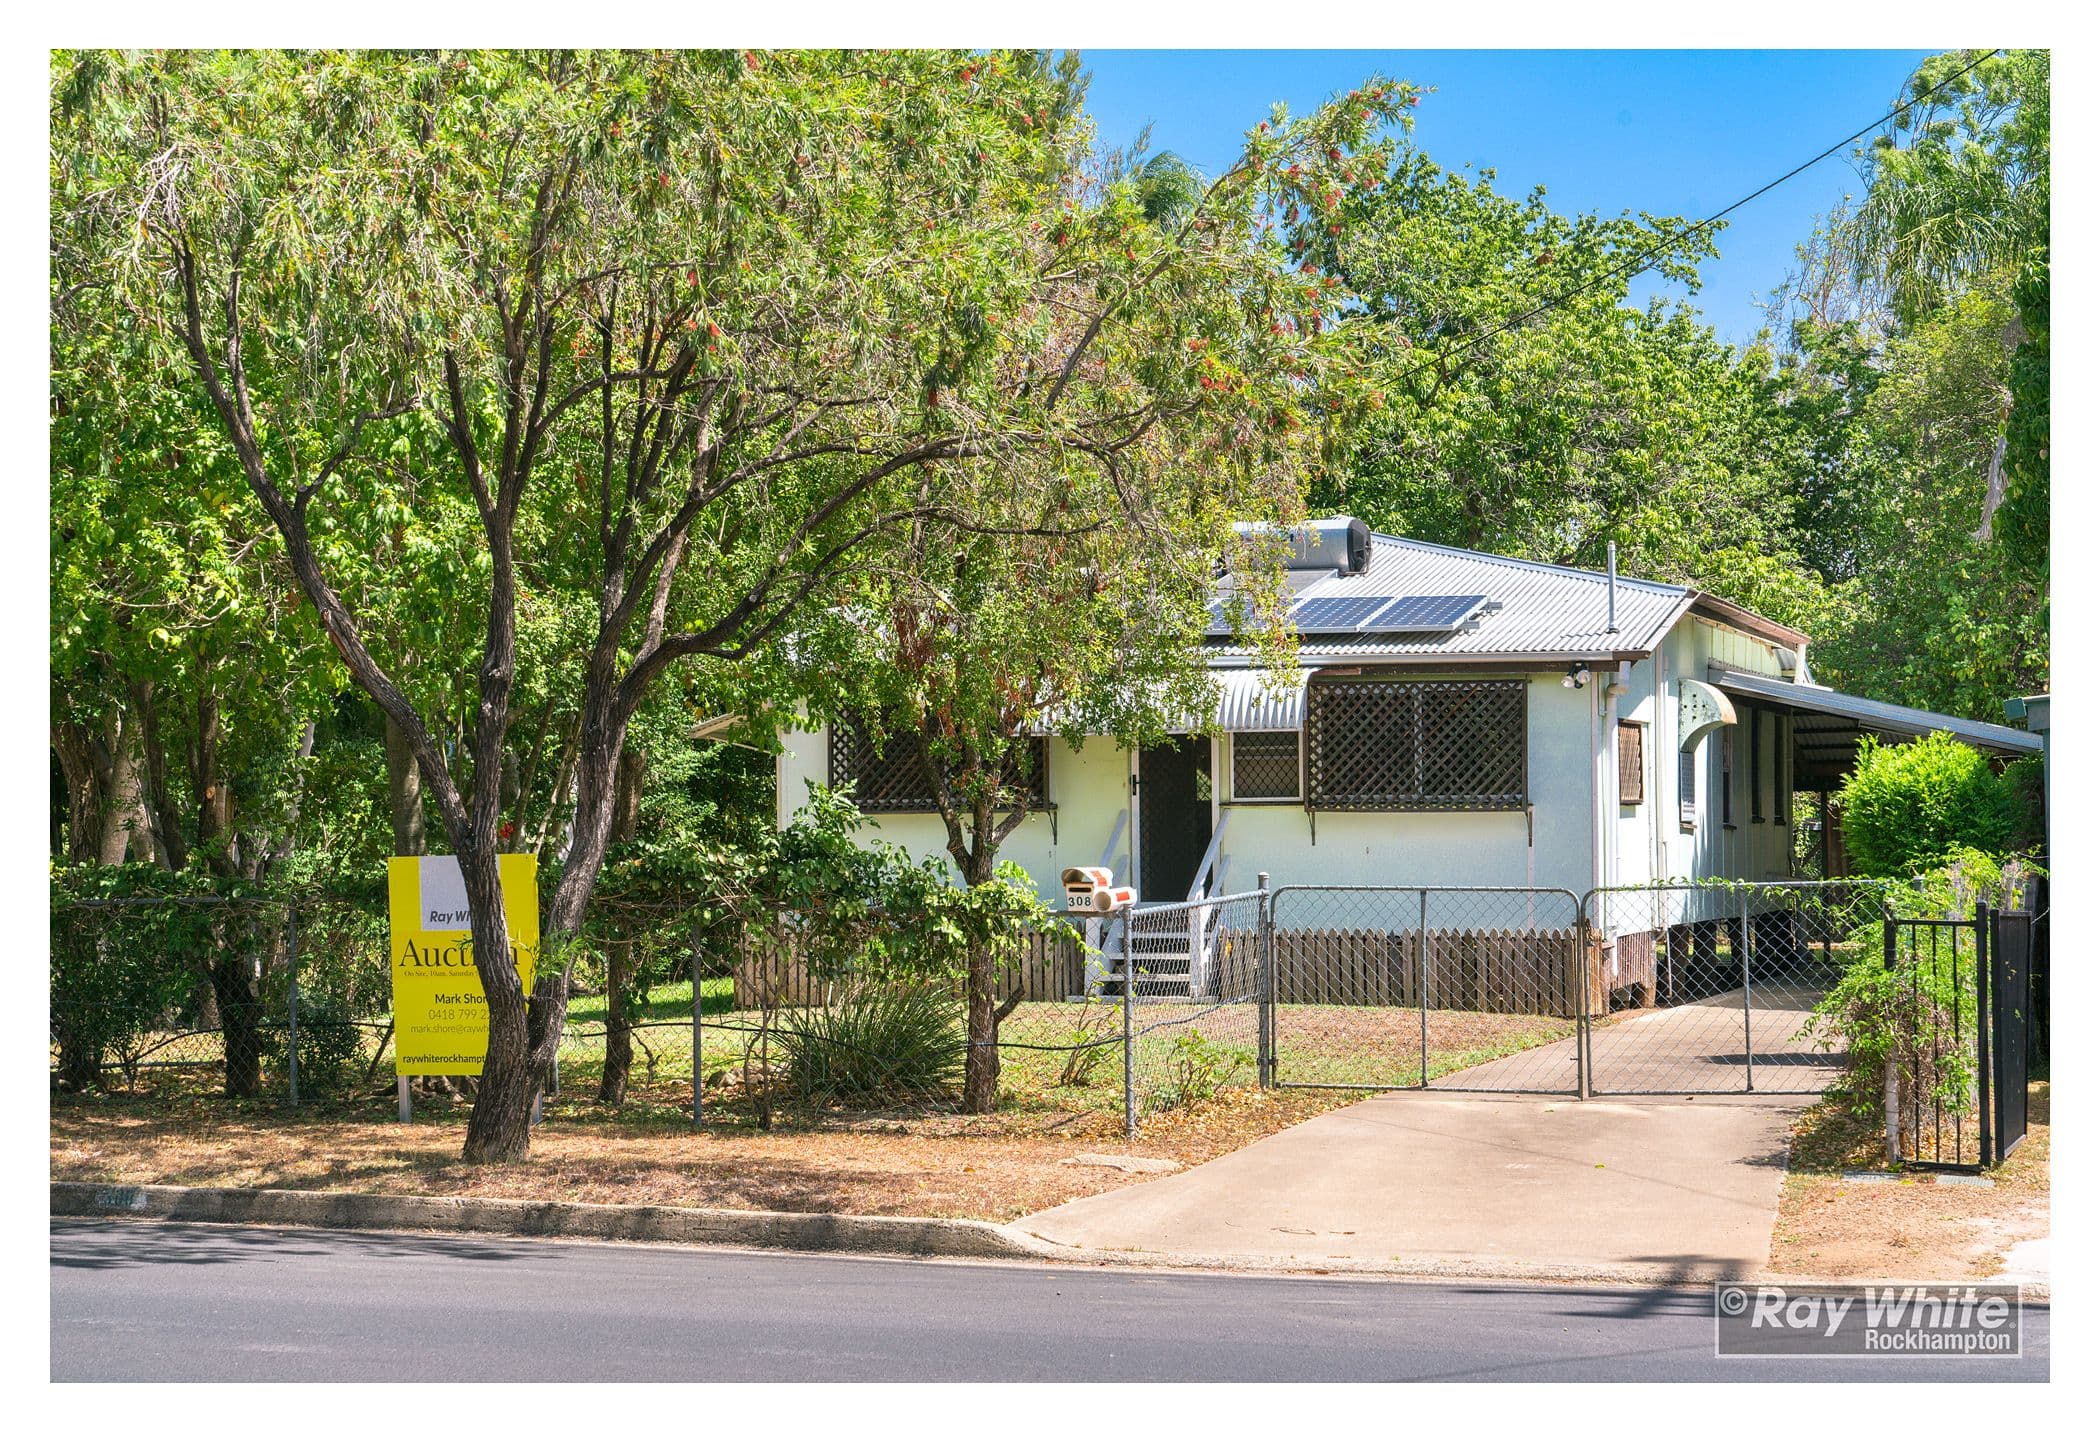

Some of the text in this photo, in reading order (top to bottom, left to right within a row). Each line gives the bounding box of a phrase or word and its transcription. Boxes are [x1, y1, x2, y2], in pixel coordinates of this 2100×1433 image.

[1068, 896, 1092, 907] 308
[430, 911, 472, 924] Ray Wh
[435, 993, 488, 1004] Mark Shor
[428, 1009, 490, 1020] 0418 799 2
[410, 1024, 490, 1035] mark.shore@raywh
[402, 1053, 486, 1065] raywhiterockhampt
